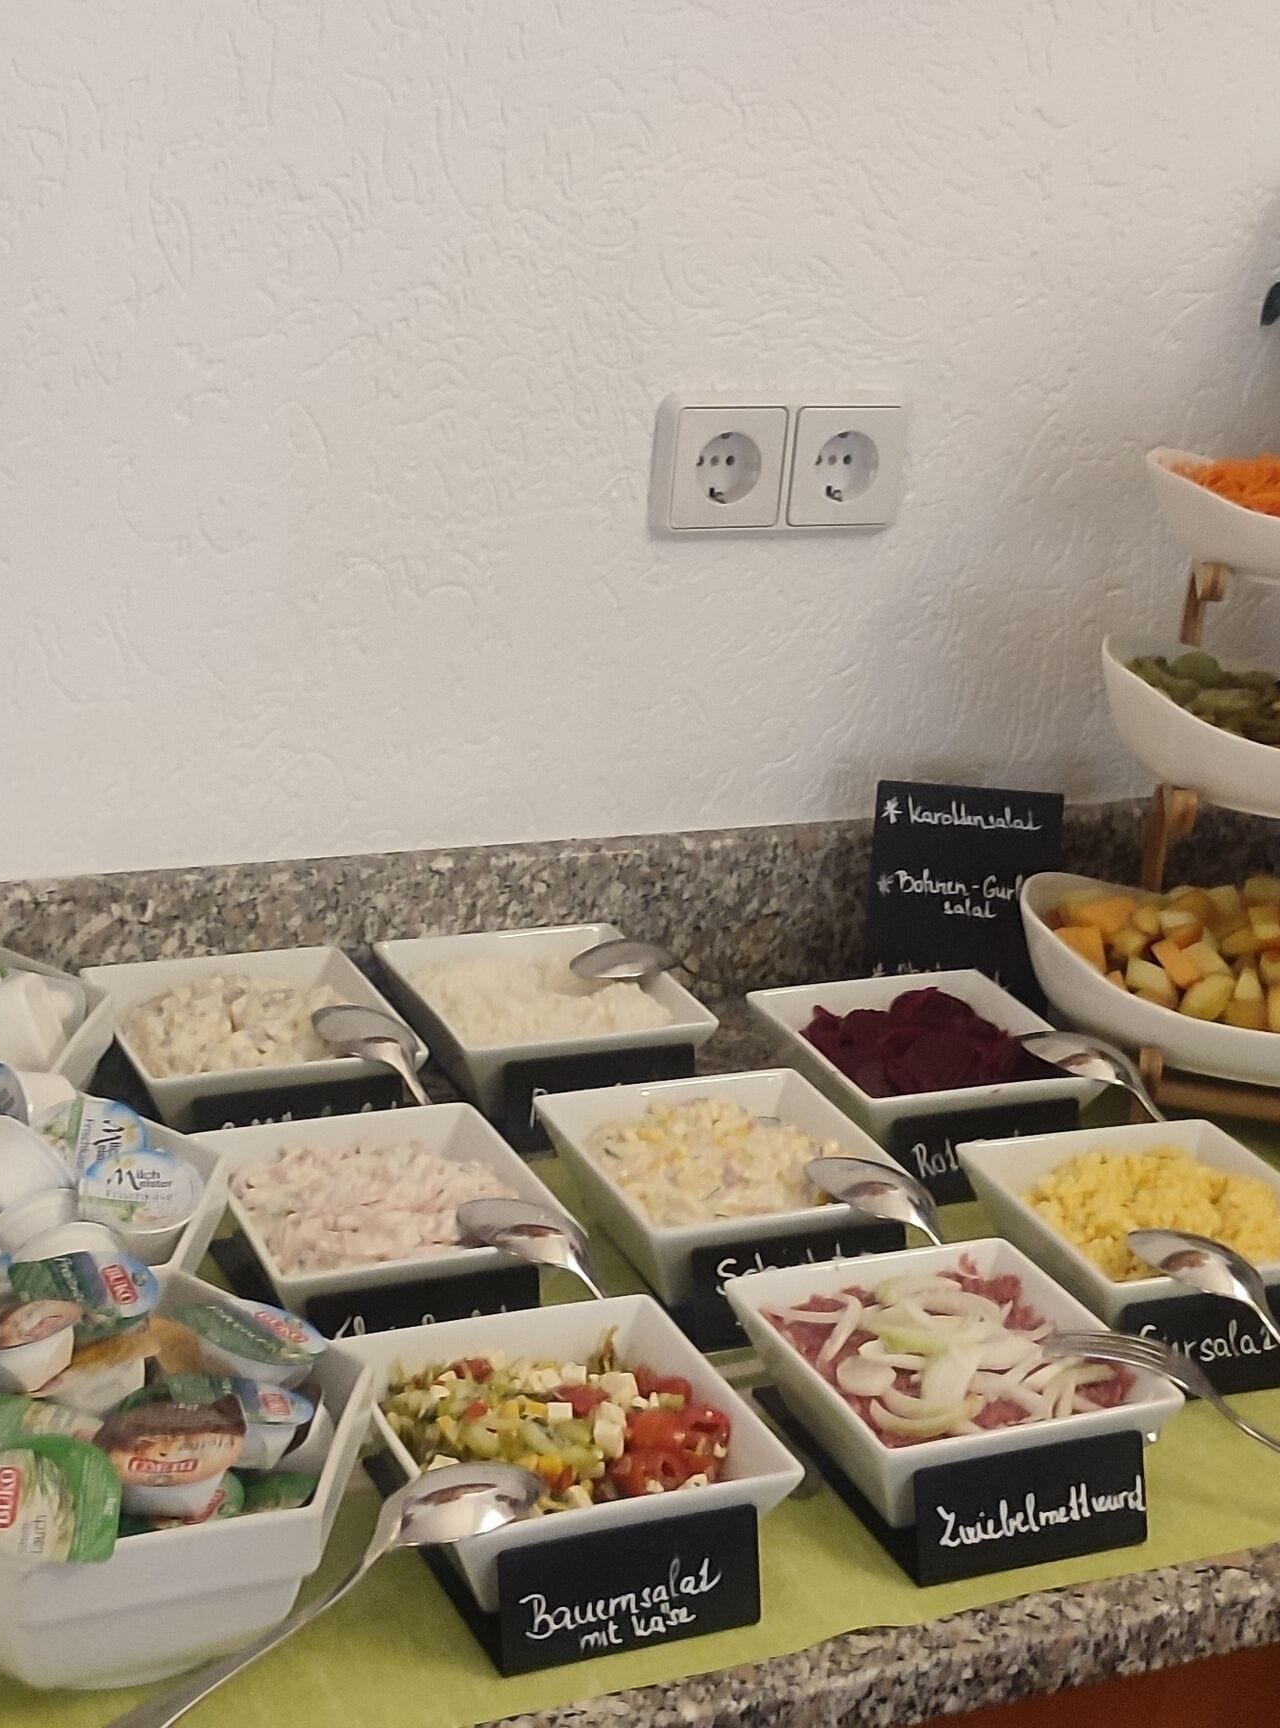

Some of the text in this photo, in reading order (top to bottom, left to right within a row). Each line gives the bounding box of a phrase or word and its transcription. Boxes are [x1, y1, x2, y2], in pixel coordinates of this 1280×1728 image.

[943, 898, 998, 919] salat
[520, 1556, 723, 1641] Bauernsalat
[579, 1623, 624, 1652] mit
